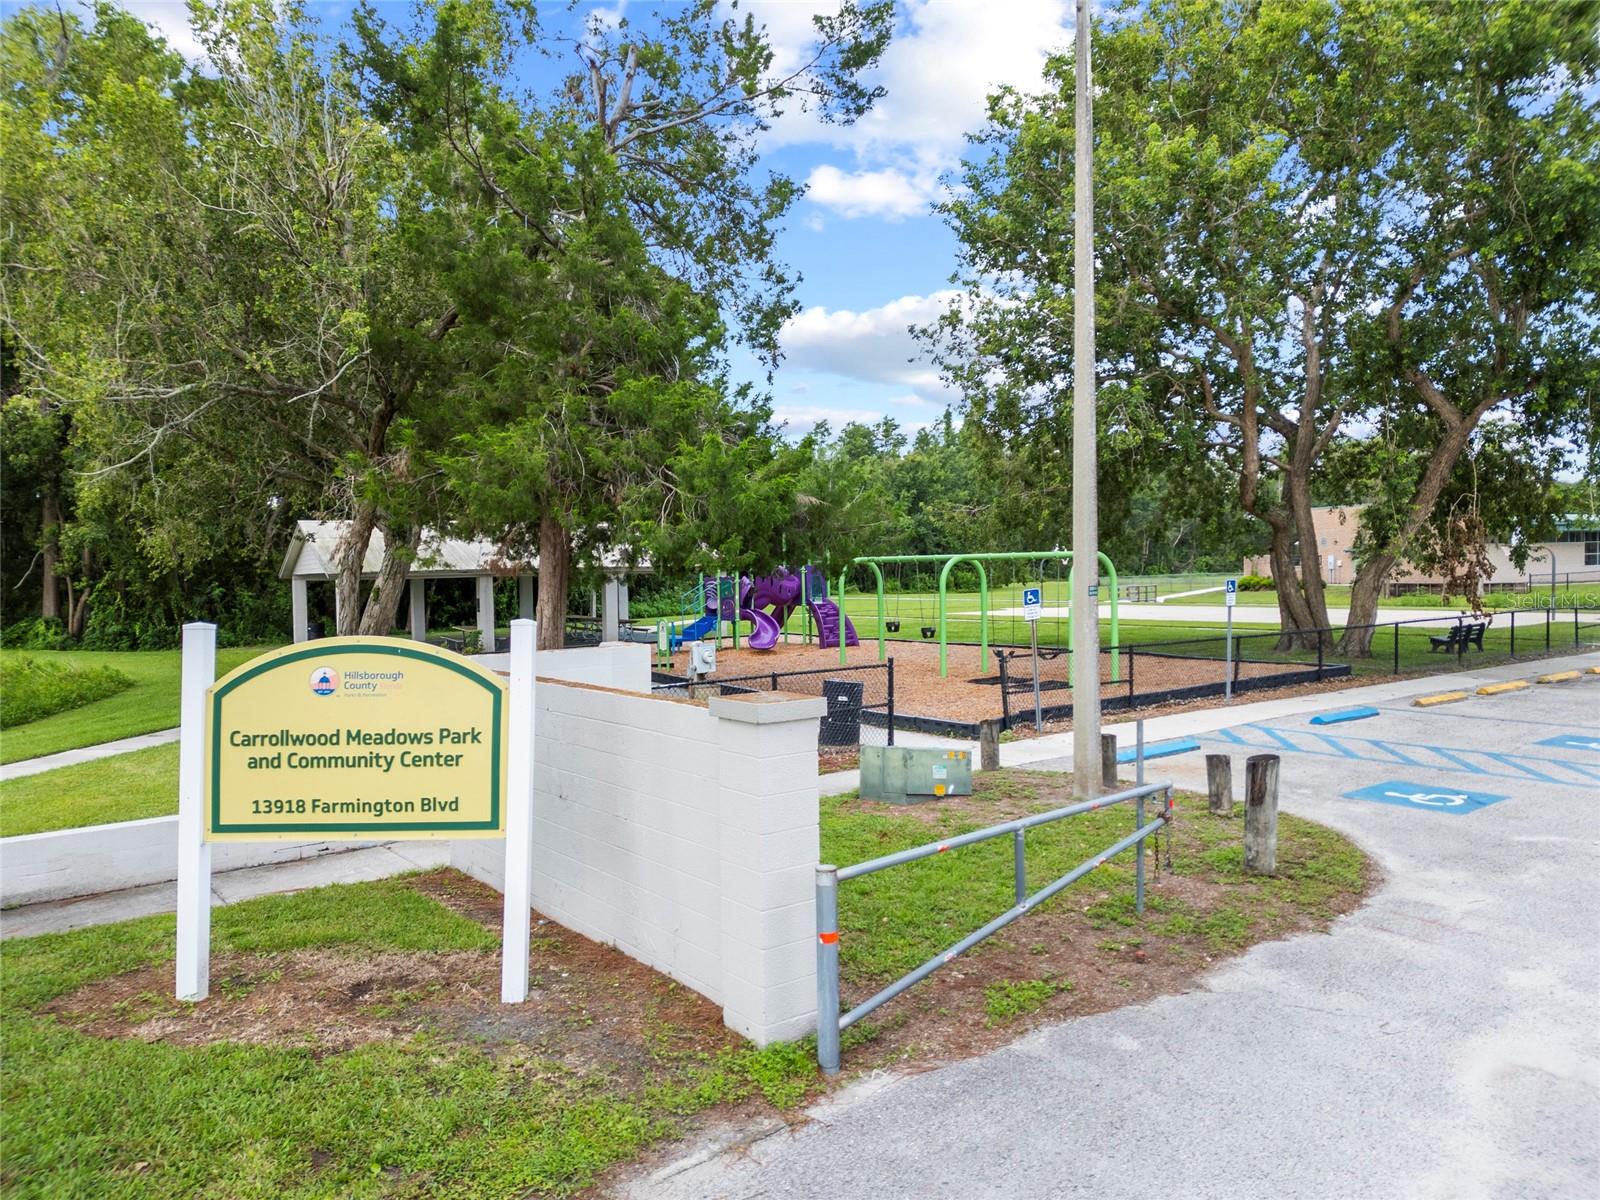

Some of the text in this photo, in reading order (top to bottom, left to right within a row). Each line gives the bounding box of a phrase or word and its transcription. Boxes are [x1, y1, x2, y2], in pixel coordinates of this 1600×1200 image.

[344, 670, 404, 682] Hillsborough
[344, 681, 378, 692] County
[229, 727, 483, 747] Carrollwood Meadows Park
[247, 751, 464, 773] and Community Center
[251, 796, 459, 817] 13918 Farmington Blvd
